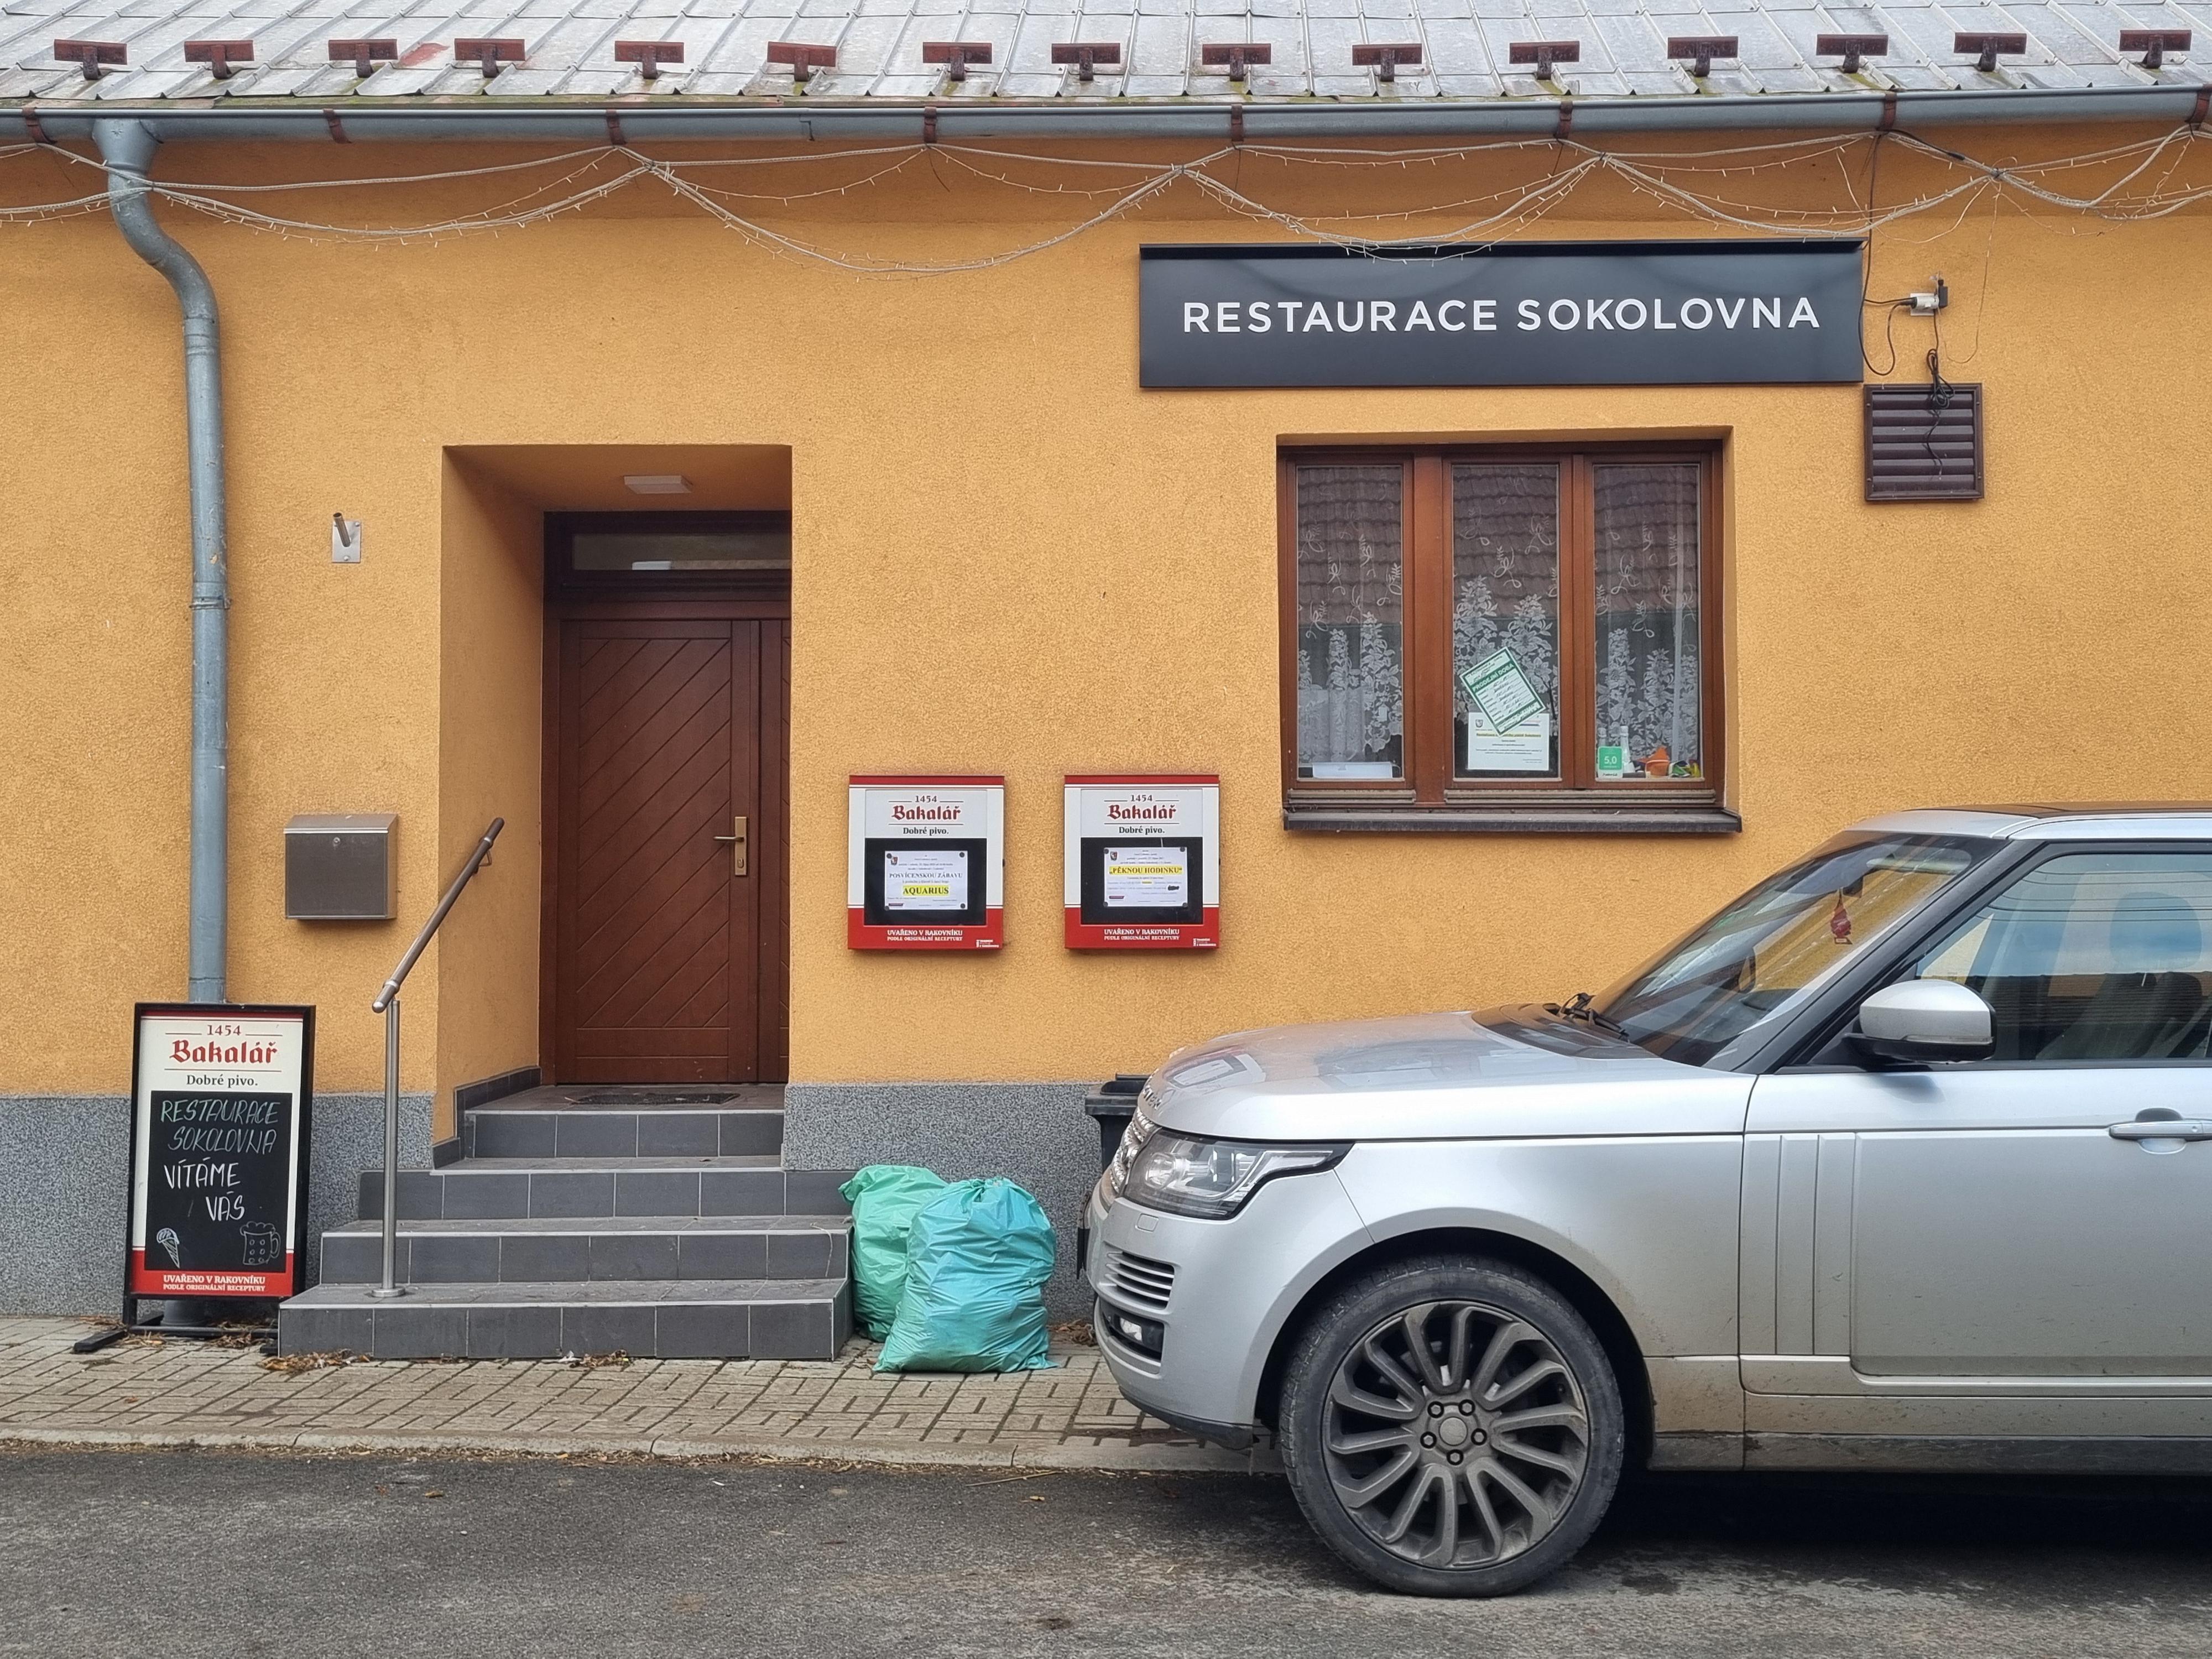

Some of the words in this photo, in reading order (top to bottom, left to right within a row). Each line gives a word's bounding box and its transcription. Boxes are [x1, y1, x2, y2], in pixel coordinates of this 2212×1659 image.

[1183, 300, 1497, 332] RESTAURACE
[1516, 297, 1820, 331] SOKOLOVNA
[1473, 671, 1498, 692] PRODEJNÍ
[1498, 663, 1514, 676] DOBA
[1604, 756, 1618, 765] 5,0
[891, 805, 961, 820] Bakalář
[1107, 805, 1176, 819] Bakalář
[929, 827, 949, 836] pivo.
[1145, 826, 1165, 836] pivo.
[903, 886, 949, 895] AQUARIUS
[207, 1024, 241, 1036] 1454
[169, 1040, 278, 1063] Bakalář
[186, 1074, 224, 1085] Dobré
[228, 1074, 258, 1088] pivo.
[160, 1099, 280, 1125] RESTAURACE
[168, 1126, 276, 1155] SOKOLOVNA
[164, 1157, 241, 1189] VÍTÁME
[206, 1191, 244, 1221] VÁS
[163, 1274, 205, 1283] UVAŘENO
[215, 1275, 265, 1284] RAKOVNÍKU
